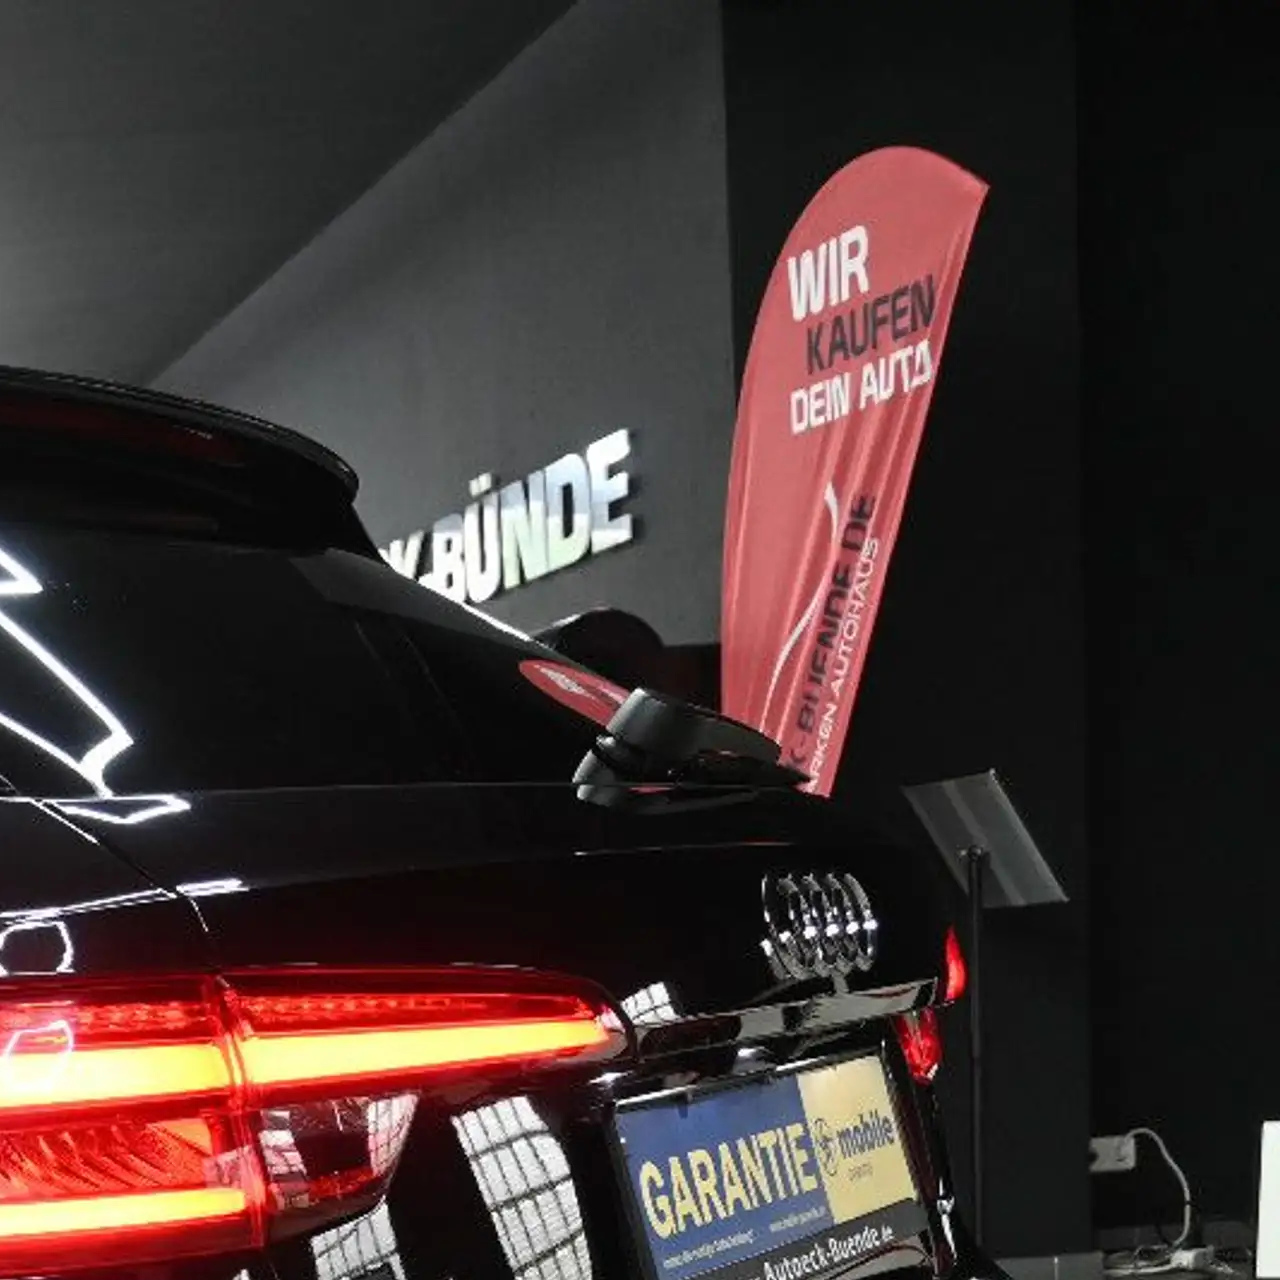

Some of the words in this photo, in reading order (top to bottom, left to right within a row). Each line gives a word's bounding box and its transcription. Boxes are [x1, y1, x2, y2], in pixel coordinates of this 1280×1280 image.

[788, 225, 870, 322] WIR
[806, 274, 936, 376] KAUFEN
[791, 371, 852, 434] DEIN
[859, 338, 933, 410] AUTO
[829, 537, 880, 697] AUTOHAUS
[639, 1122, 818, 1239] GARANTIE
[836, 1108, 895, 1159] mobile
